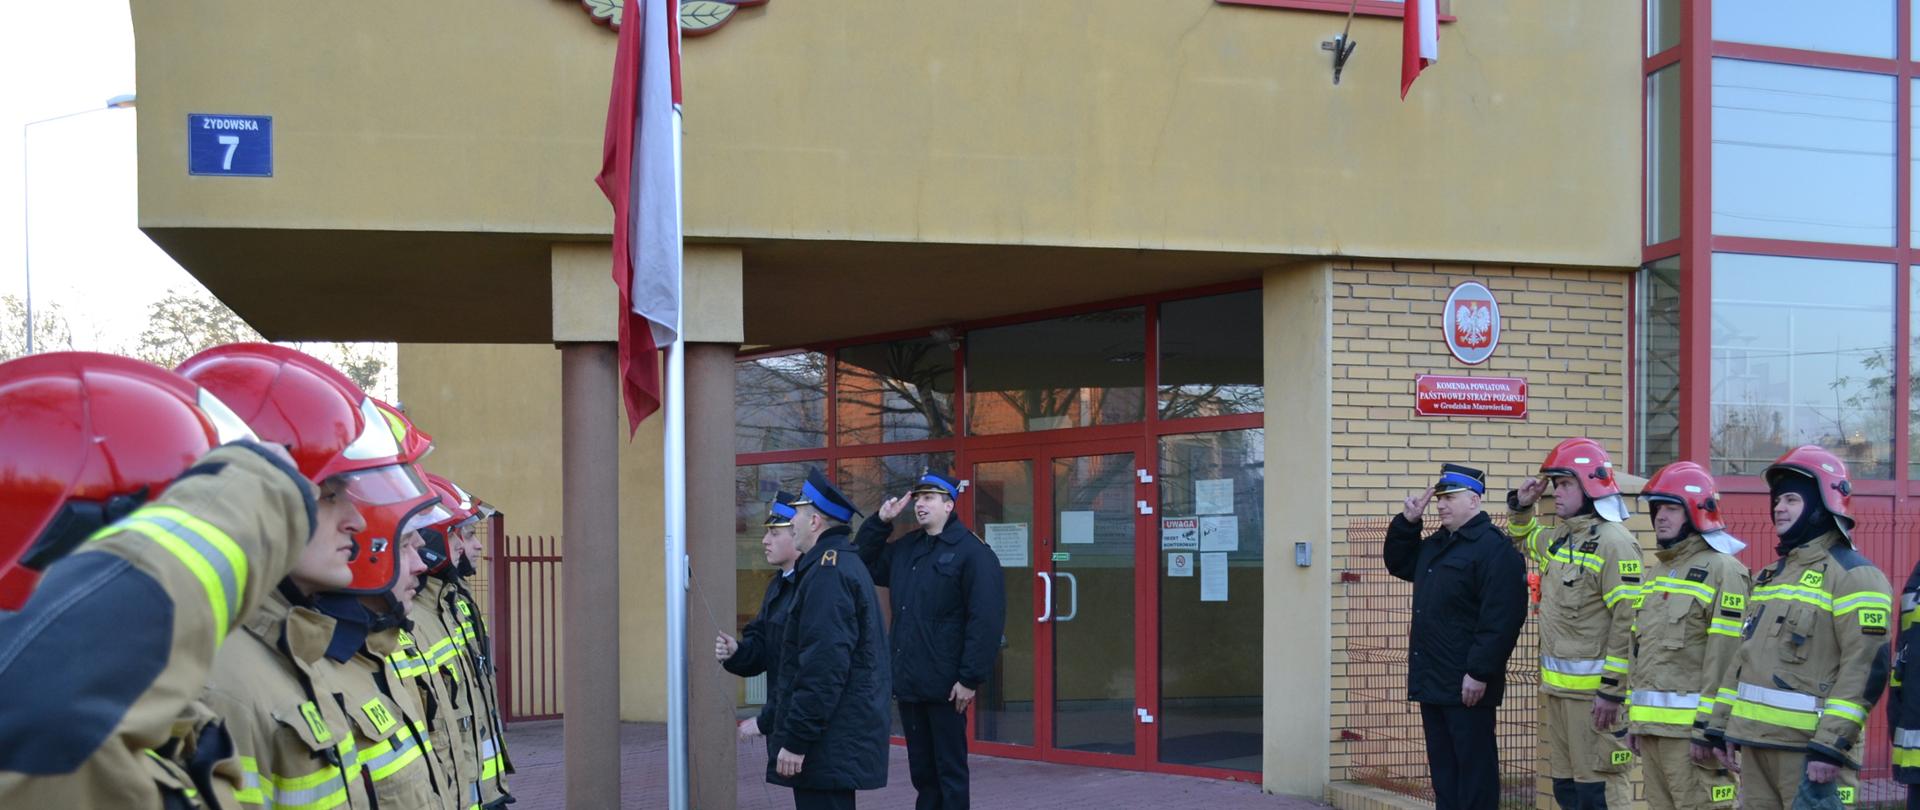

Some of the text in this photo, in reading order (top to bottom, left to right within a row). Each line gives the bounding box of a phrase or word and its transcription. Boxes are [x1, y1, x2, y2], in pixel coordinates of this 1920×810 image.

[218, 135, 240, 170] 7
[1436, 382, 1510, 391] KOMENDA POWIATOWA
[1166, 520, 1194, 528] UWAGA
[1622, 563, 1638, 572] PSP
[1723, 595, 1741, 606] PSP
[1864, 613, 1883, 624] PSP
[1614, 752, 1630, 762] PSP
[1715, 787, 1732, 798] PSP
